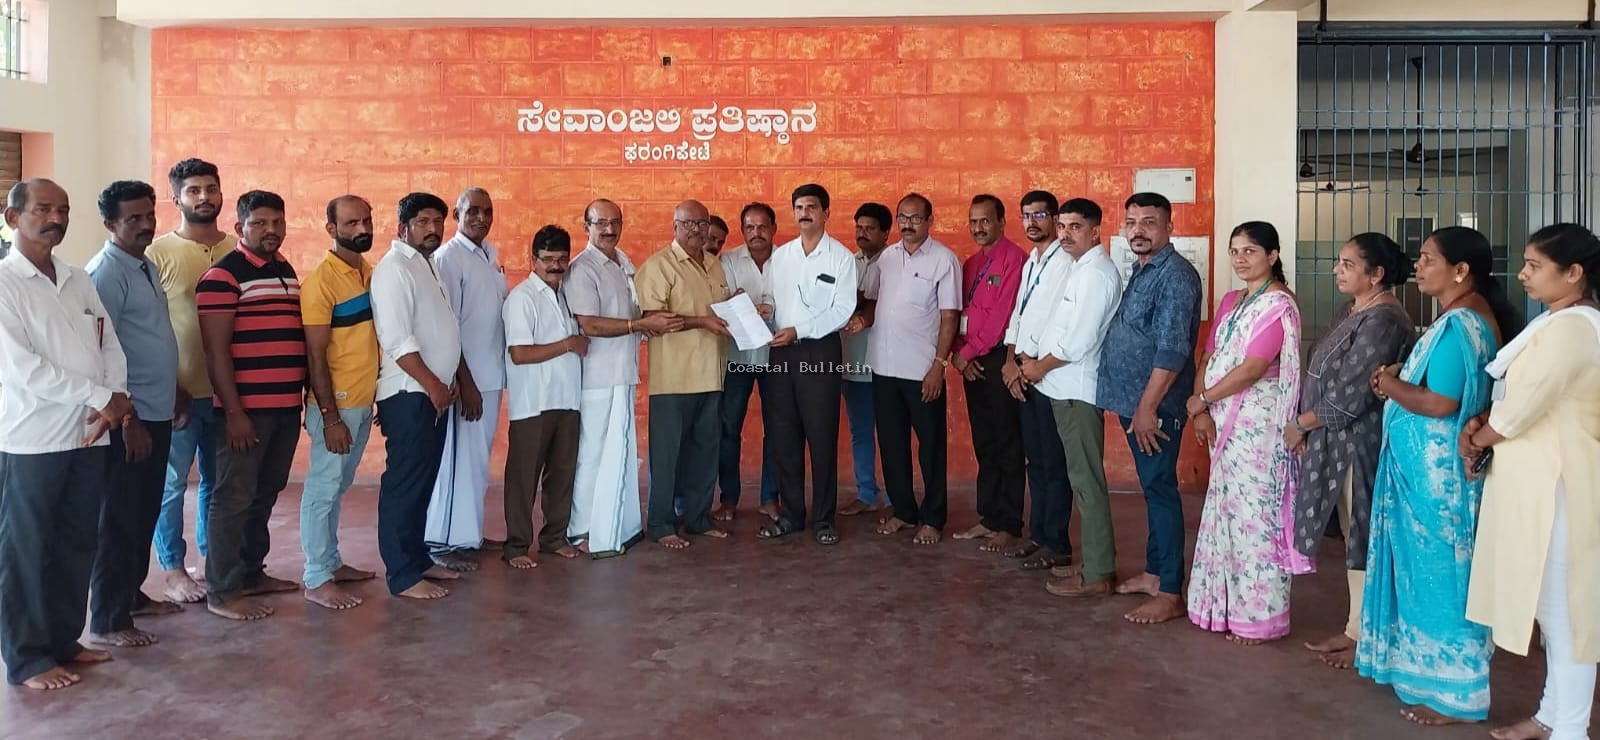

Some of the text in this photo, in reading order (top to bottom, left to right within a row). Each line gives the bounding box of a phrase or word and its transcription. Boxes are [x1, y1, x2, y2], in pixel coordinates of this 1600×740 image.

[517, 100, 817, 145] ಸೇವಾಂಜಲಿ ಪ್ರತಿಷ್ಠಾನ
[624, 141, 710, 164] ಫರಂಗಿಪೇಟೆ
